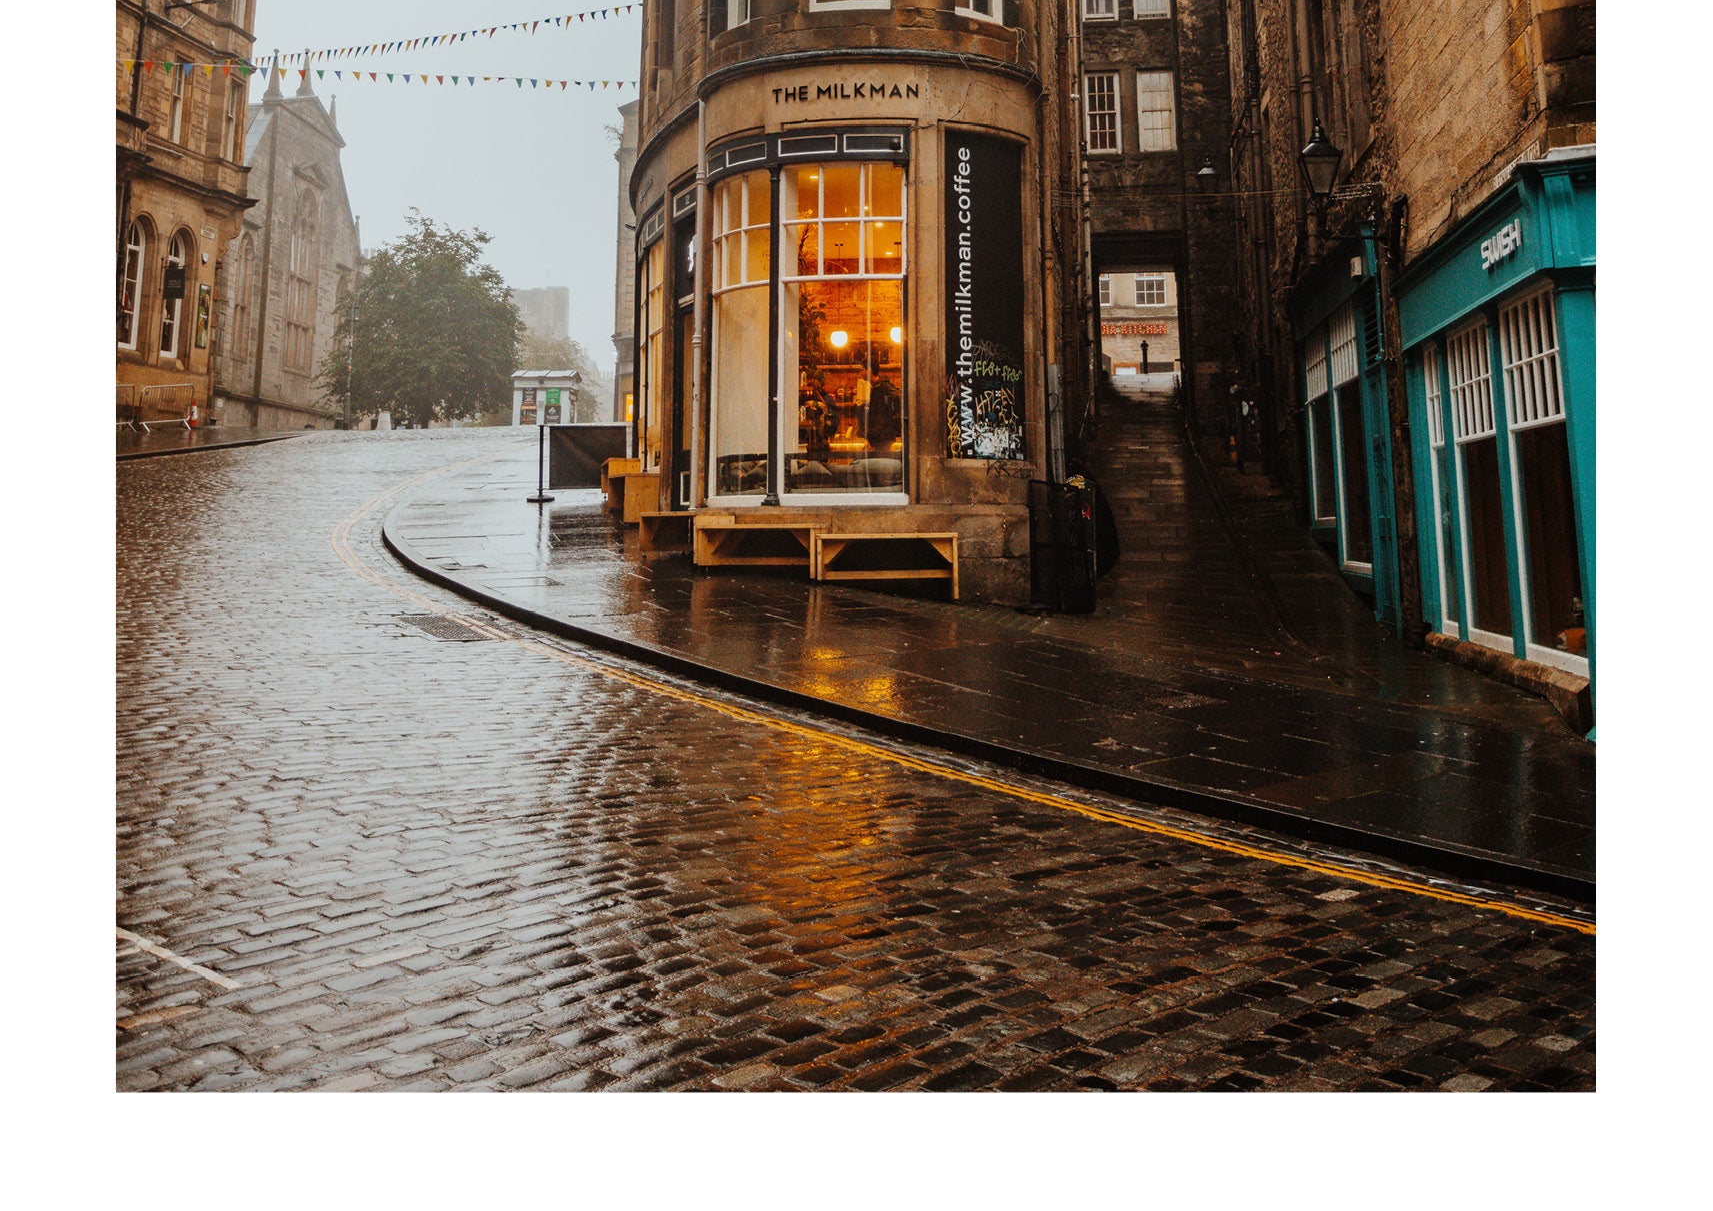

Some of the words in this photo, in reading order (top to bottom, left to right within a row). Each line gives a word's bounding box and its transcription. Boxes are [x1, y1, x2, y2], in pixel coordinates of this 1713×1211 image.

[772, 86, 808, 103] THE
[816, 82, 919, 99] MILKMAN
[1481, 219, 1521, 270] SWISH
[953, 146, 973, 446] www.themilkman.coffee
